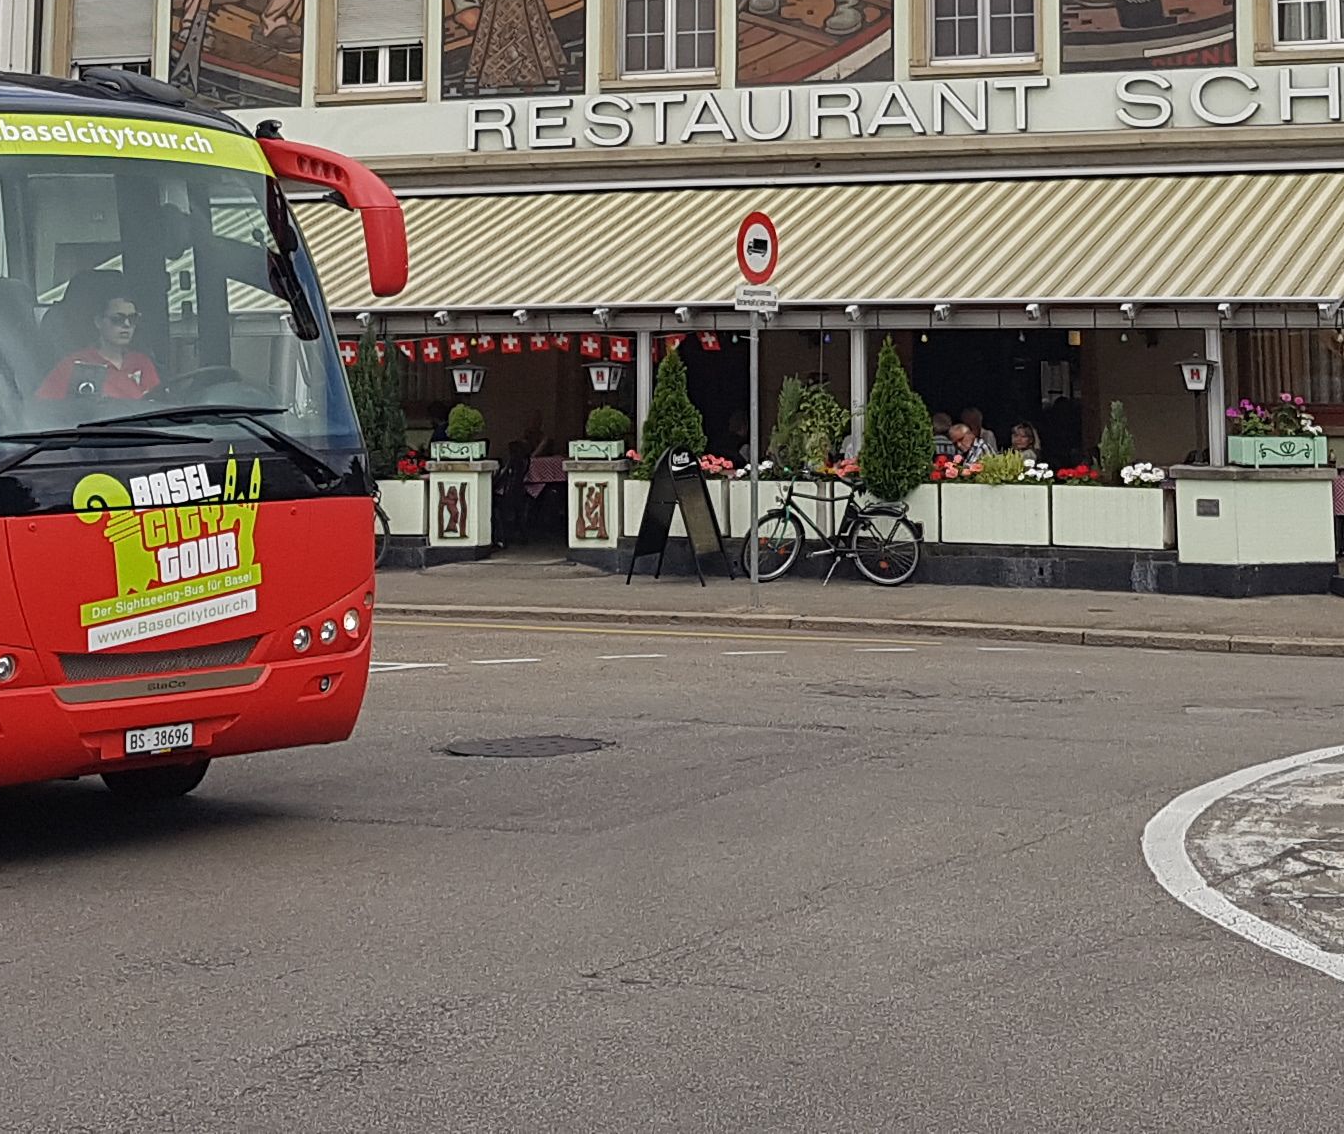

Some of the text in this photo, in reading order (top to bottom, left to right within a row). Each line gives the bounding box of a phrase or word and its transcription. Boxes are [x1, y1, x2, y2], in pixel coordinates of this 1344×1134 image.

[466, 76, 1050, 151] RESTAURANT
[129, 463, 222, 512] BASEL
[92, 571, 253, 620] Der Sightseeing-Bus für Basel
[97, 596, 249, 644] www.BaselCitytour.ch
